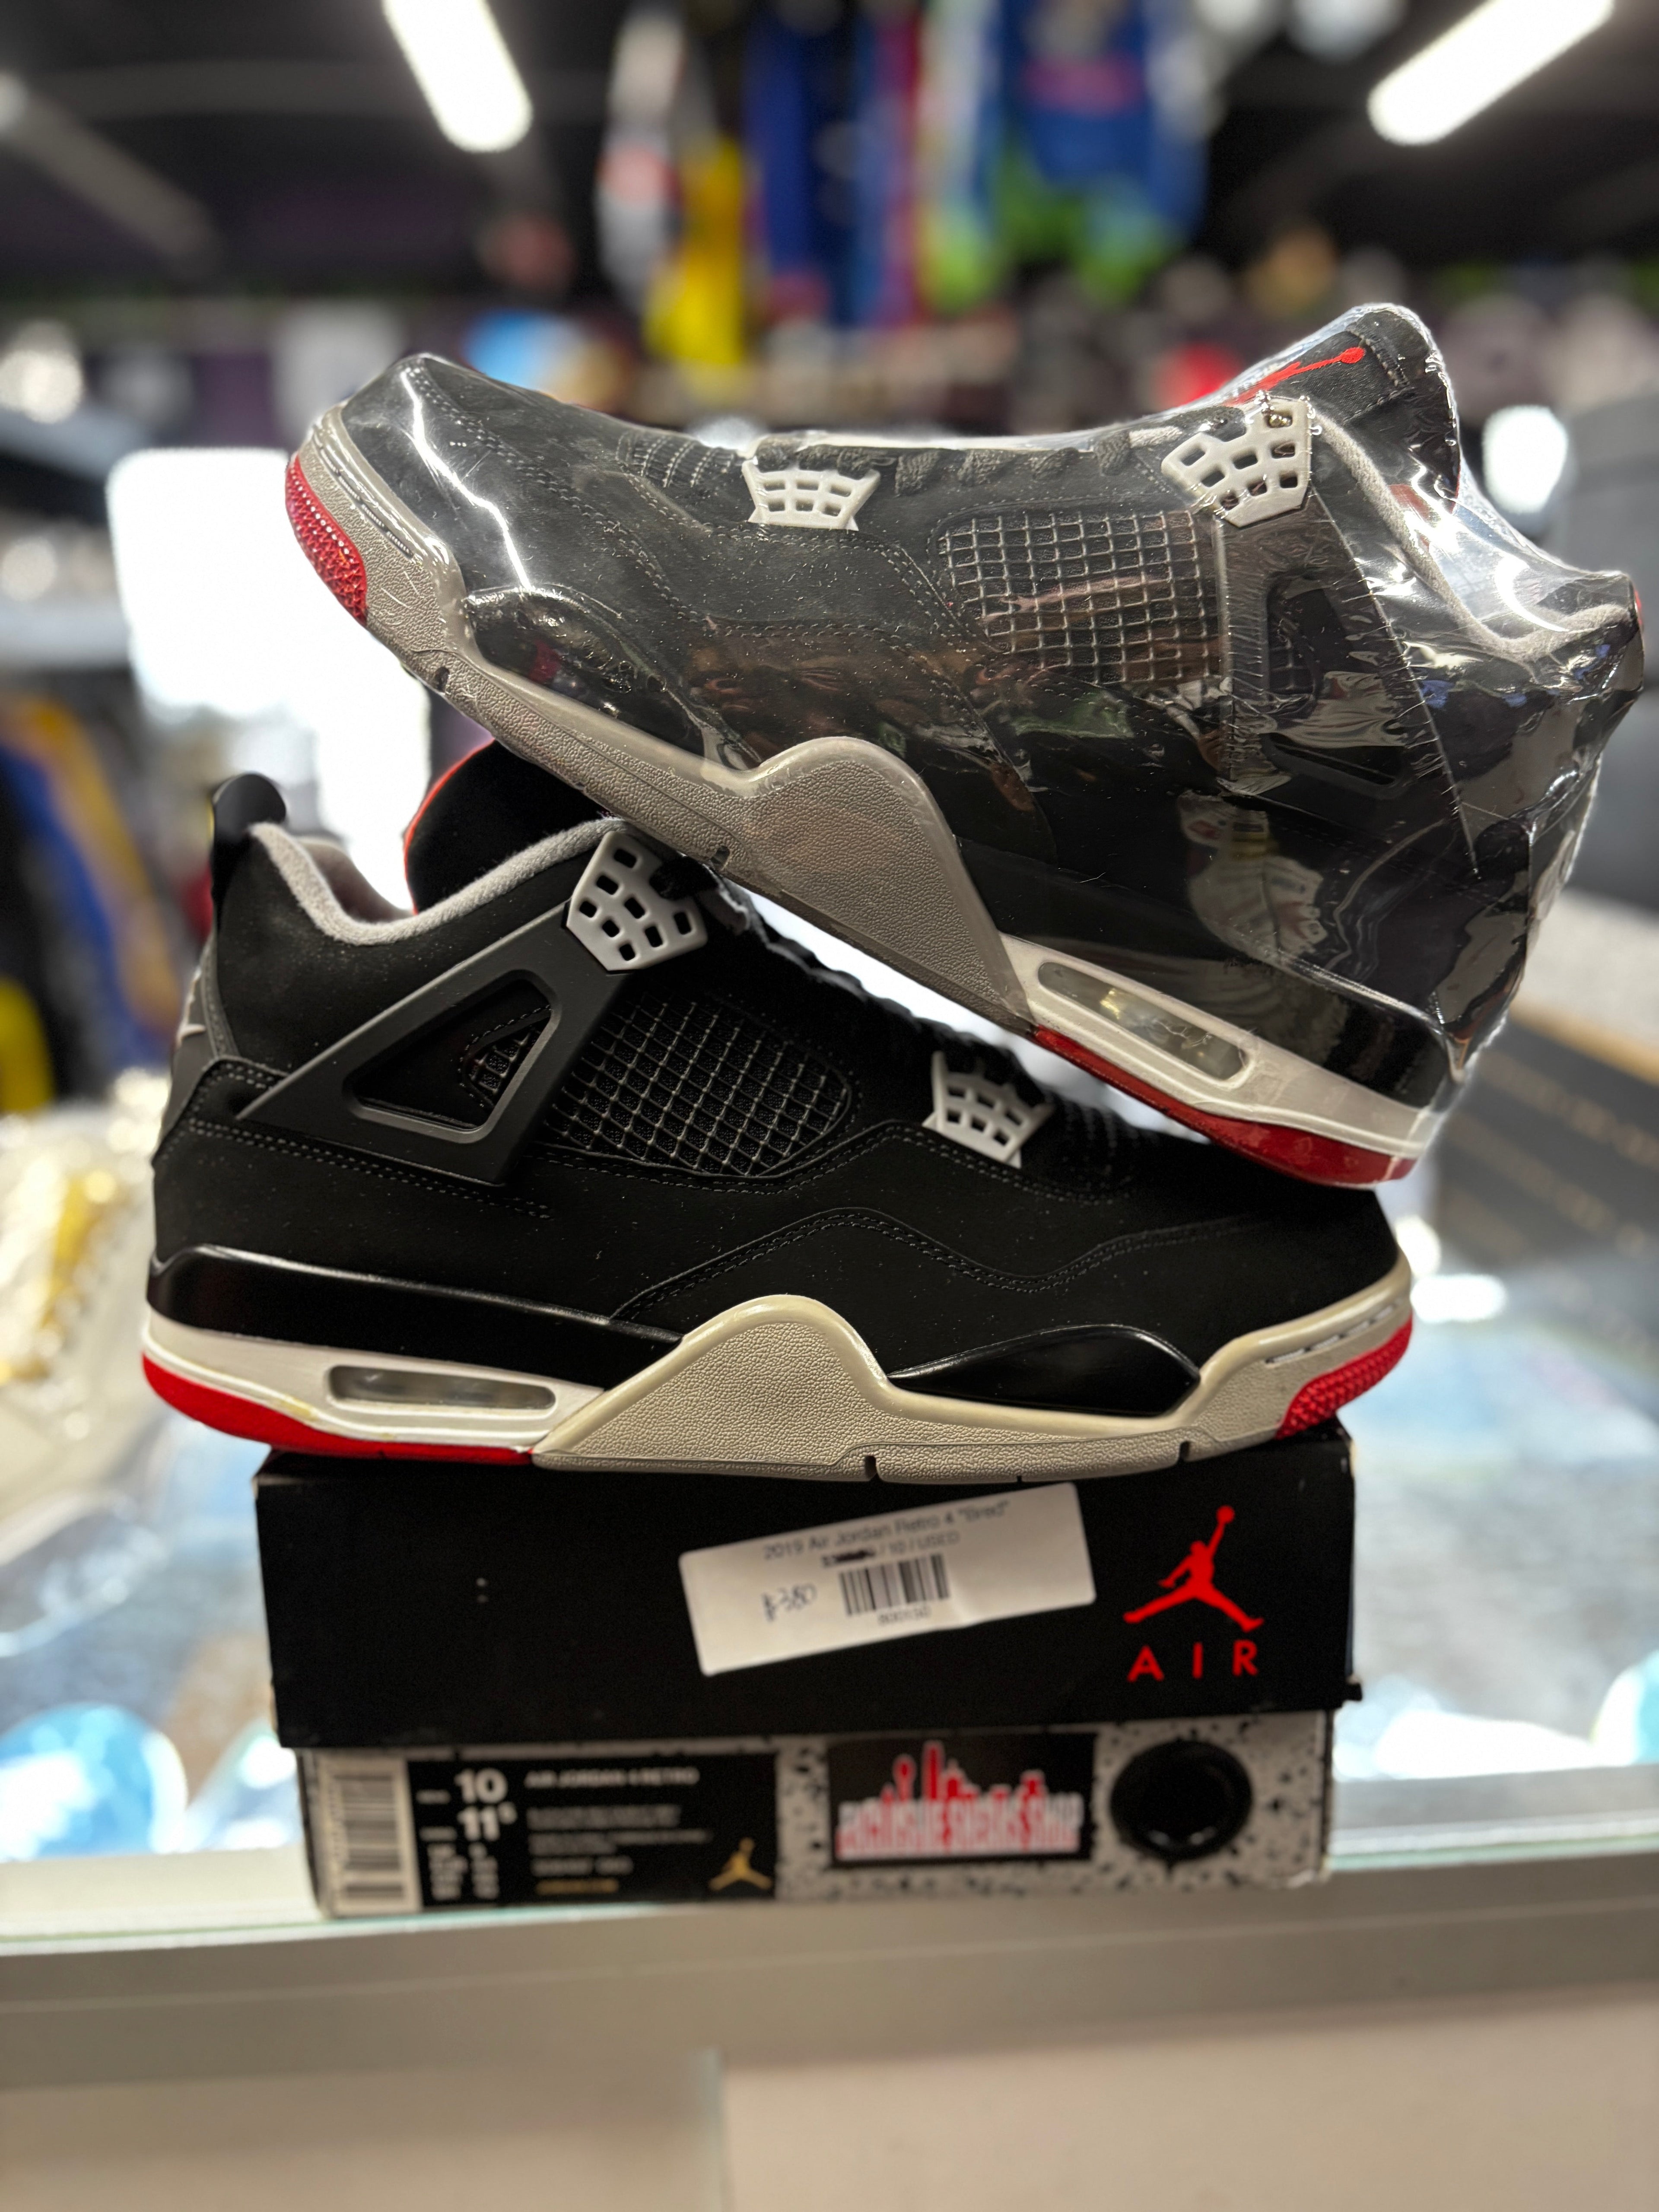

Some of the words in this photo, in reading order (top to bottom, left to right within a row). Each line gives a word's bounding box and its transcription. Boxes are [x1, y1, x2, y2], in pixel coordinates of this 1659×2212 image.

[808, 1535, 829, 1551] Air
[835, 1522, 891, 1546] Jordan
[894, 1516, 939, 1535] Retro
[918, 1530, 961, 1550] USED
[1127, 1639, 1258, 1683] AIR
[455, 1768, 508, 1804] 10
